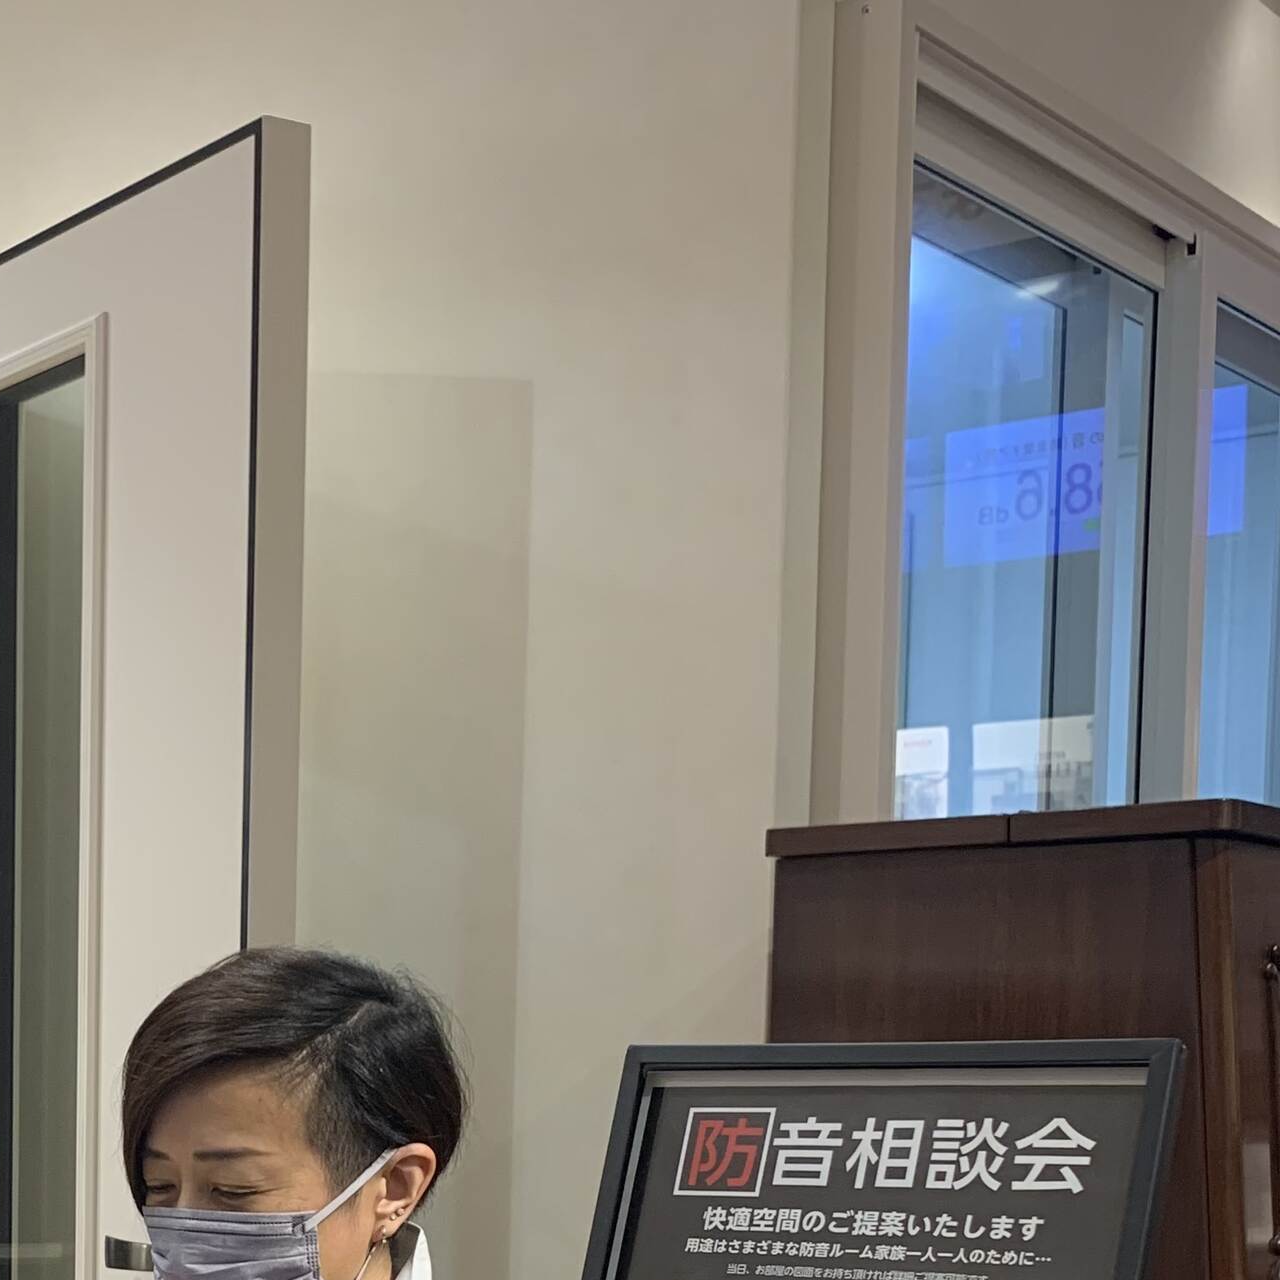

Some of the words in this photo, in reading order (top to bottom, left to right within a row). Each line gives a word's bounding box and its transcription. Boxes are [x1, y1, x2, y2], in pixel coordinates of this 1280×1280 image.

[686, 1115, 1097, 1194] 防音相談会
[702, 1206, 1045, 1242] 快適空間のご提案いたします
